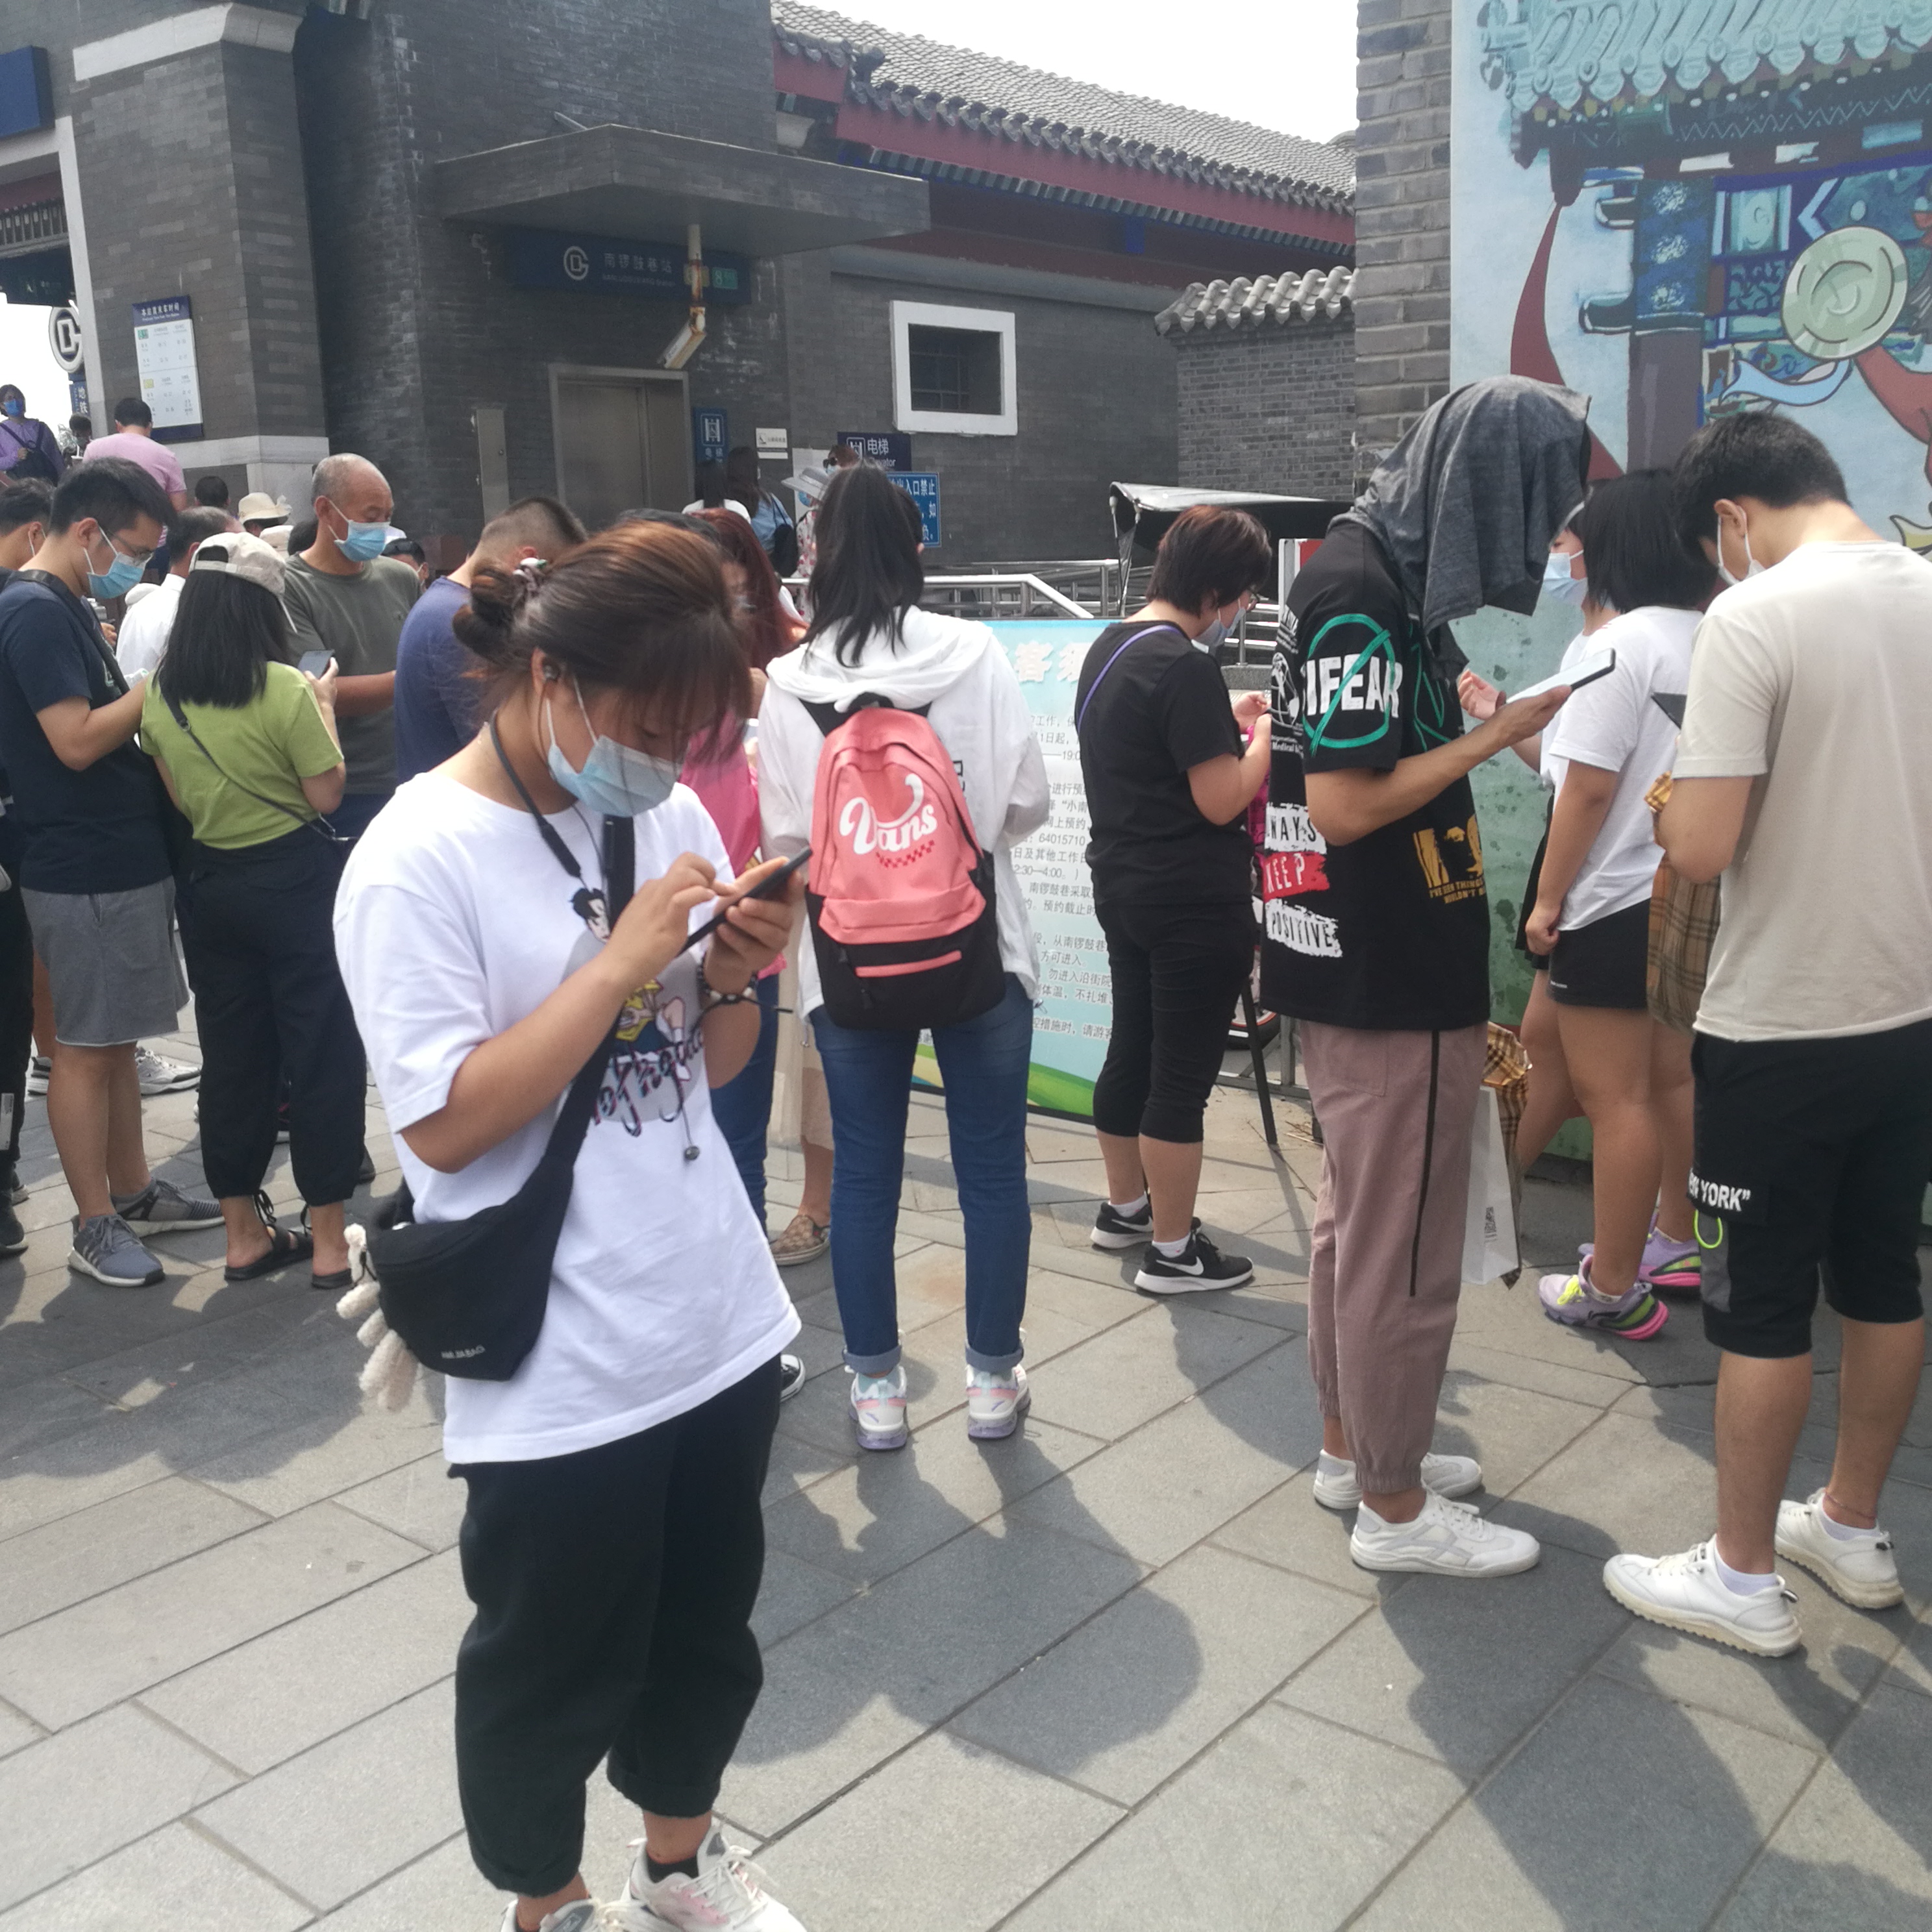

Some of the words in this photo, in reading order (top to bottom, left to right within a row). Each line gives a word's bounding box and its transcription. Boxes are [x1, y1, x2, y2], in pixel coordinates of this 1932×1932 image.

[867, 438, 889, 455] 电梯
[839, 773, 937, 855] Vans
[1029, 882, 1093, 898] 南锣鼓巷采取
[1271, 910, 1333, 948] POSITIVE
